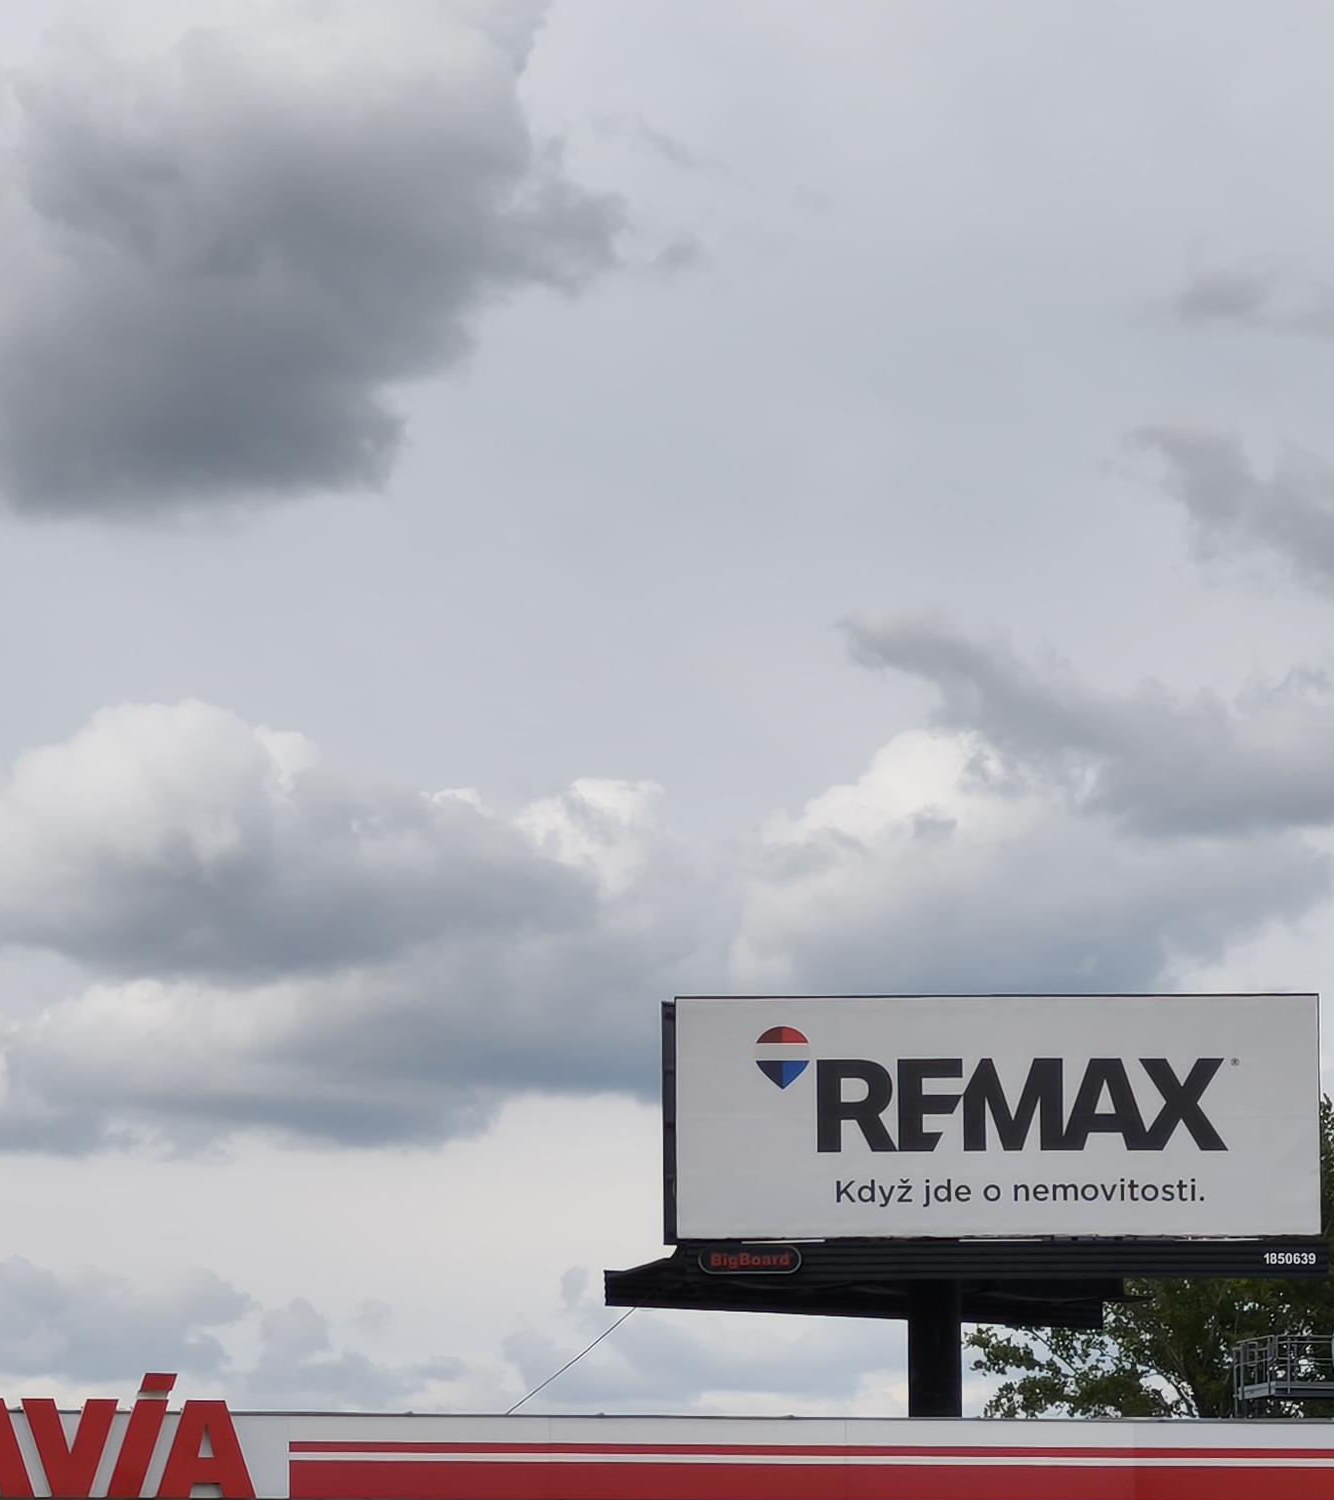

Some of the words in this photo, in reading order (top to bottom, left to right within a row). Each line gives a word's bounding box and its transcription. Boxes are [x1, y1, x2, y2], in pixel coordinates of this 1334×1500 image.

[816, 1057, 1229, 1153] REMAX
[835, 1179, 914, 1208] Když
[923, 1179, 972, 1207] jde
[983, 1185, 1002, 1202] o
[1013, 1178, 1206, 1202] nemovitosti.
[710, 1252, 790, 1269] BigBoard
[1263, 1252, 1316, 1265] 1850639
